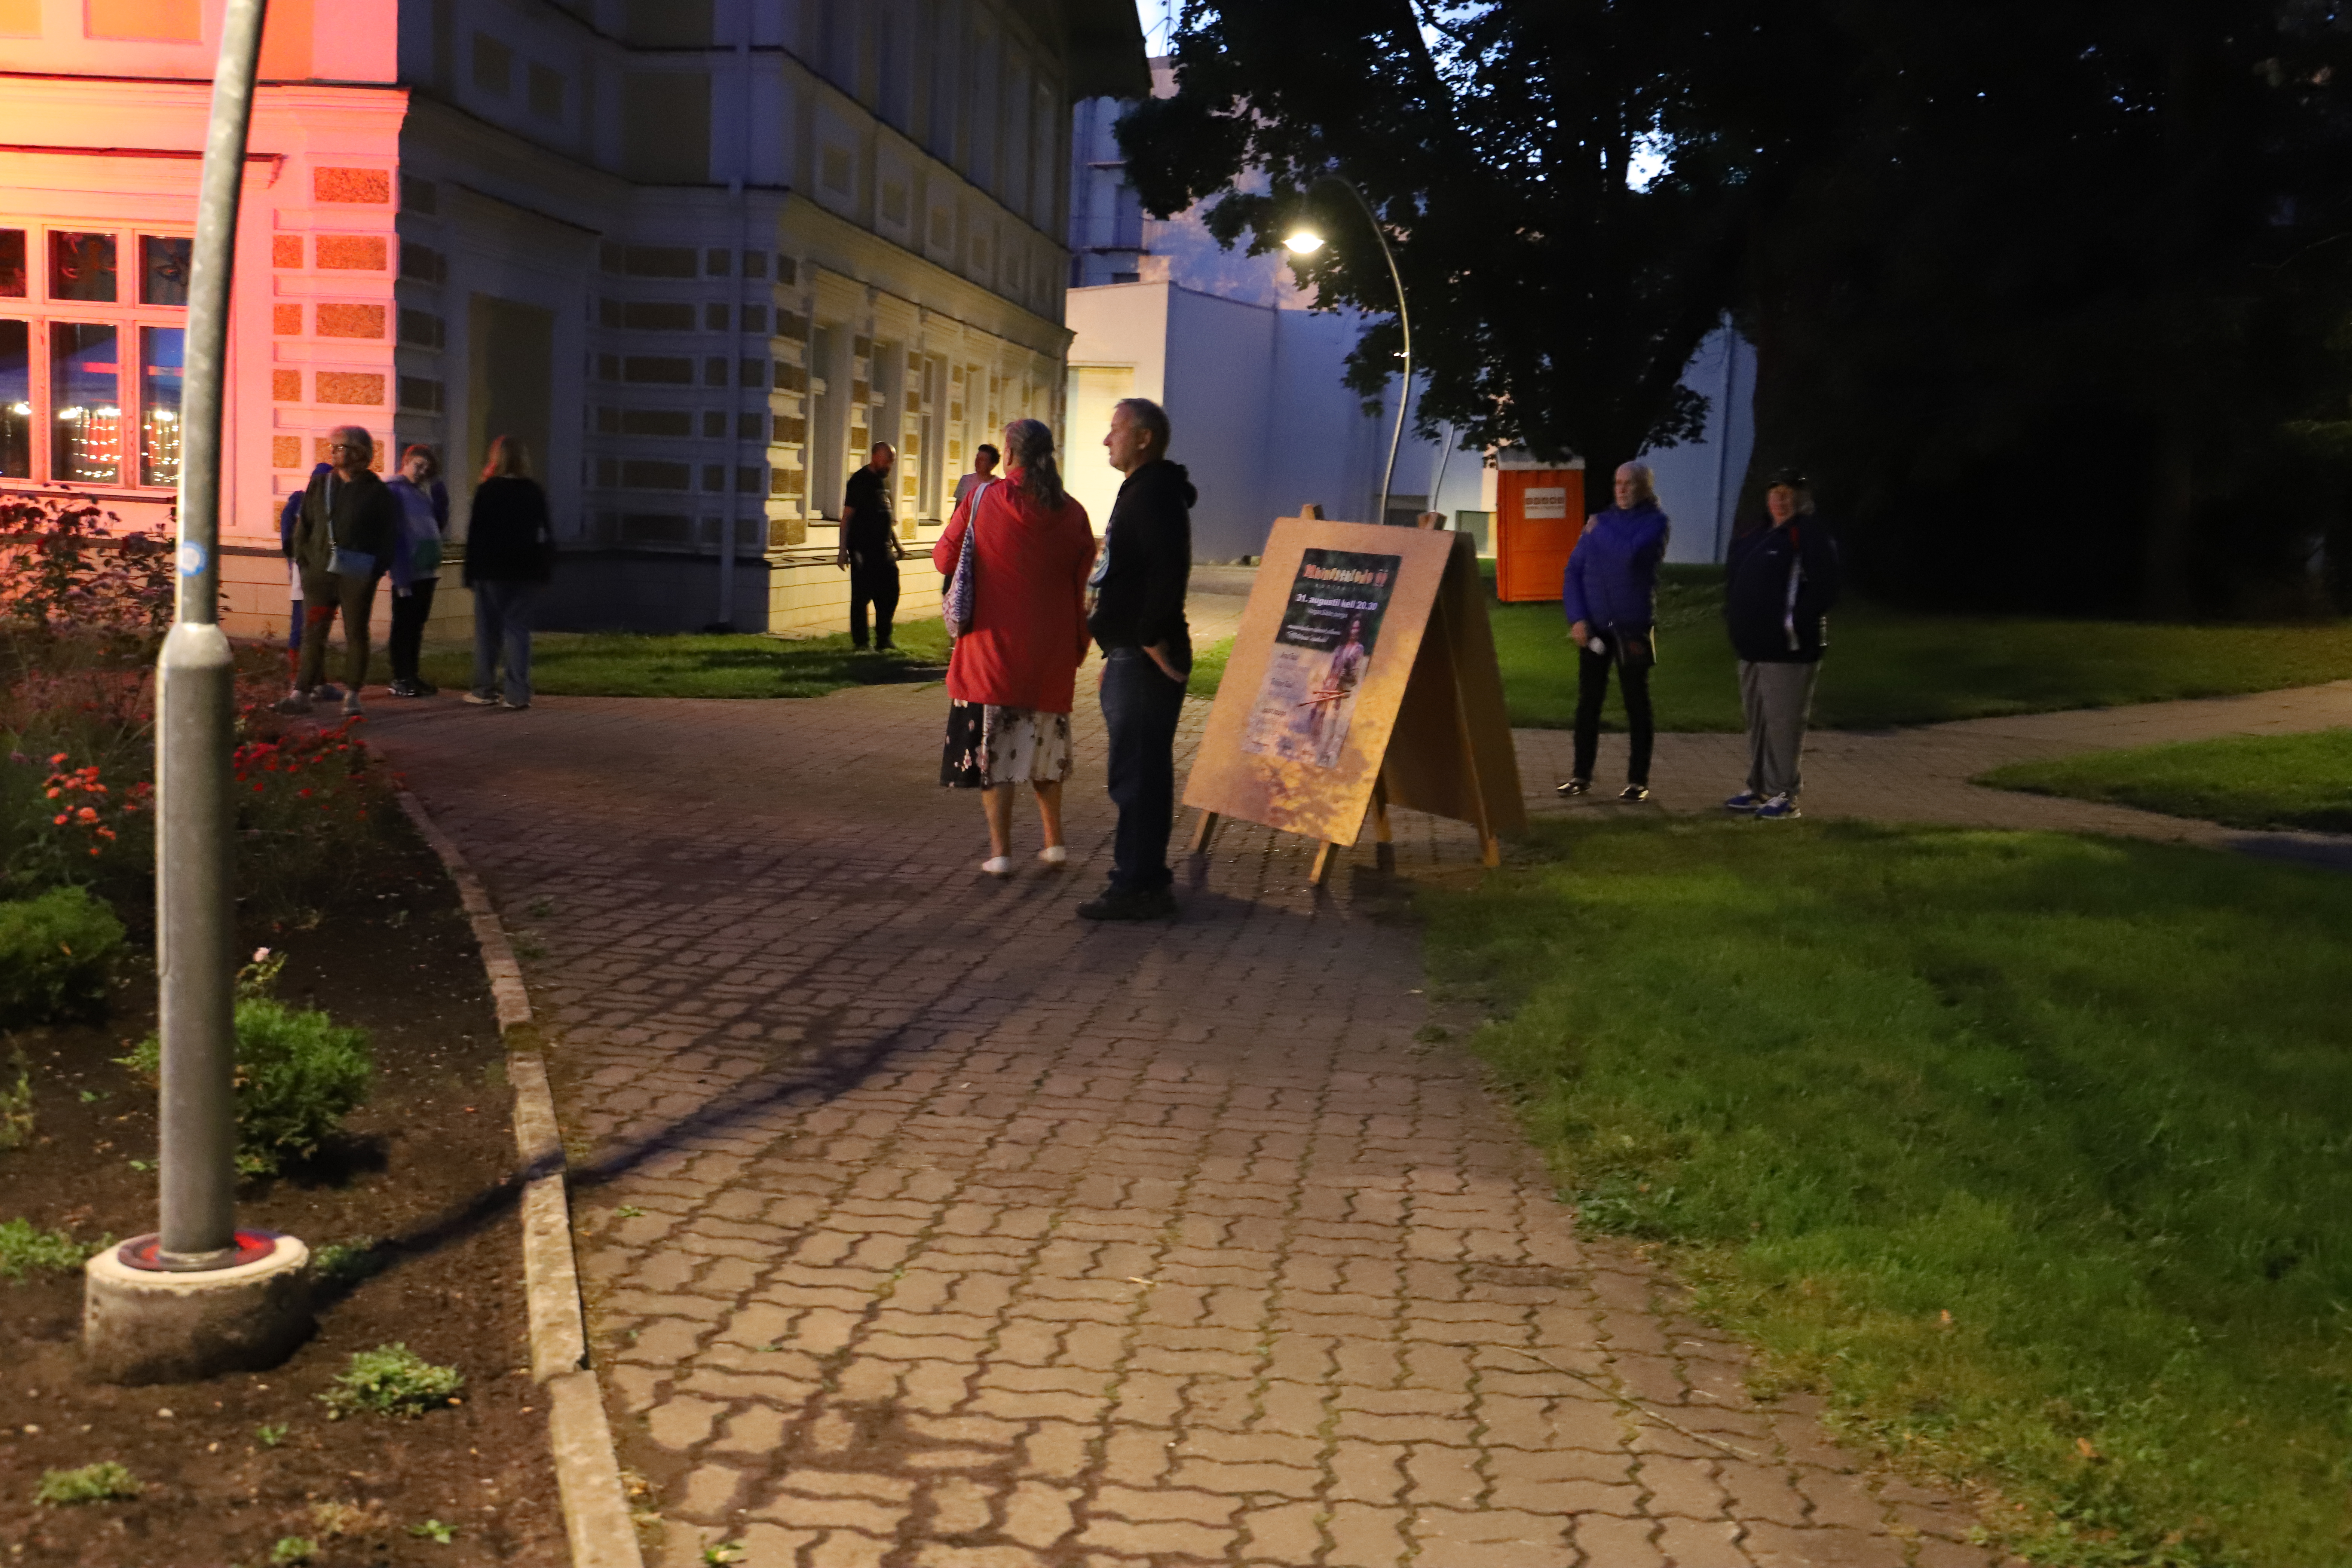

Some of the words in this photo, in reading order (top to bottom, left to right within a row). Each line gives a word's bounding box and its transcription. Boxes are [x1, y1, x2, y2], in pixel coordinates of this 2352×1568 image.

[1295, 594, 1308, 602] 31.
[1308, 597, 1341, 606] augustil
[1341, 599, 1357, 609] kell
[1356, 601, 1378, 611] 20.30
